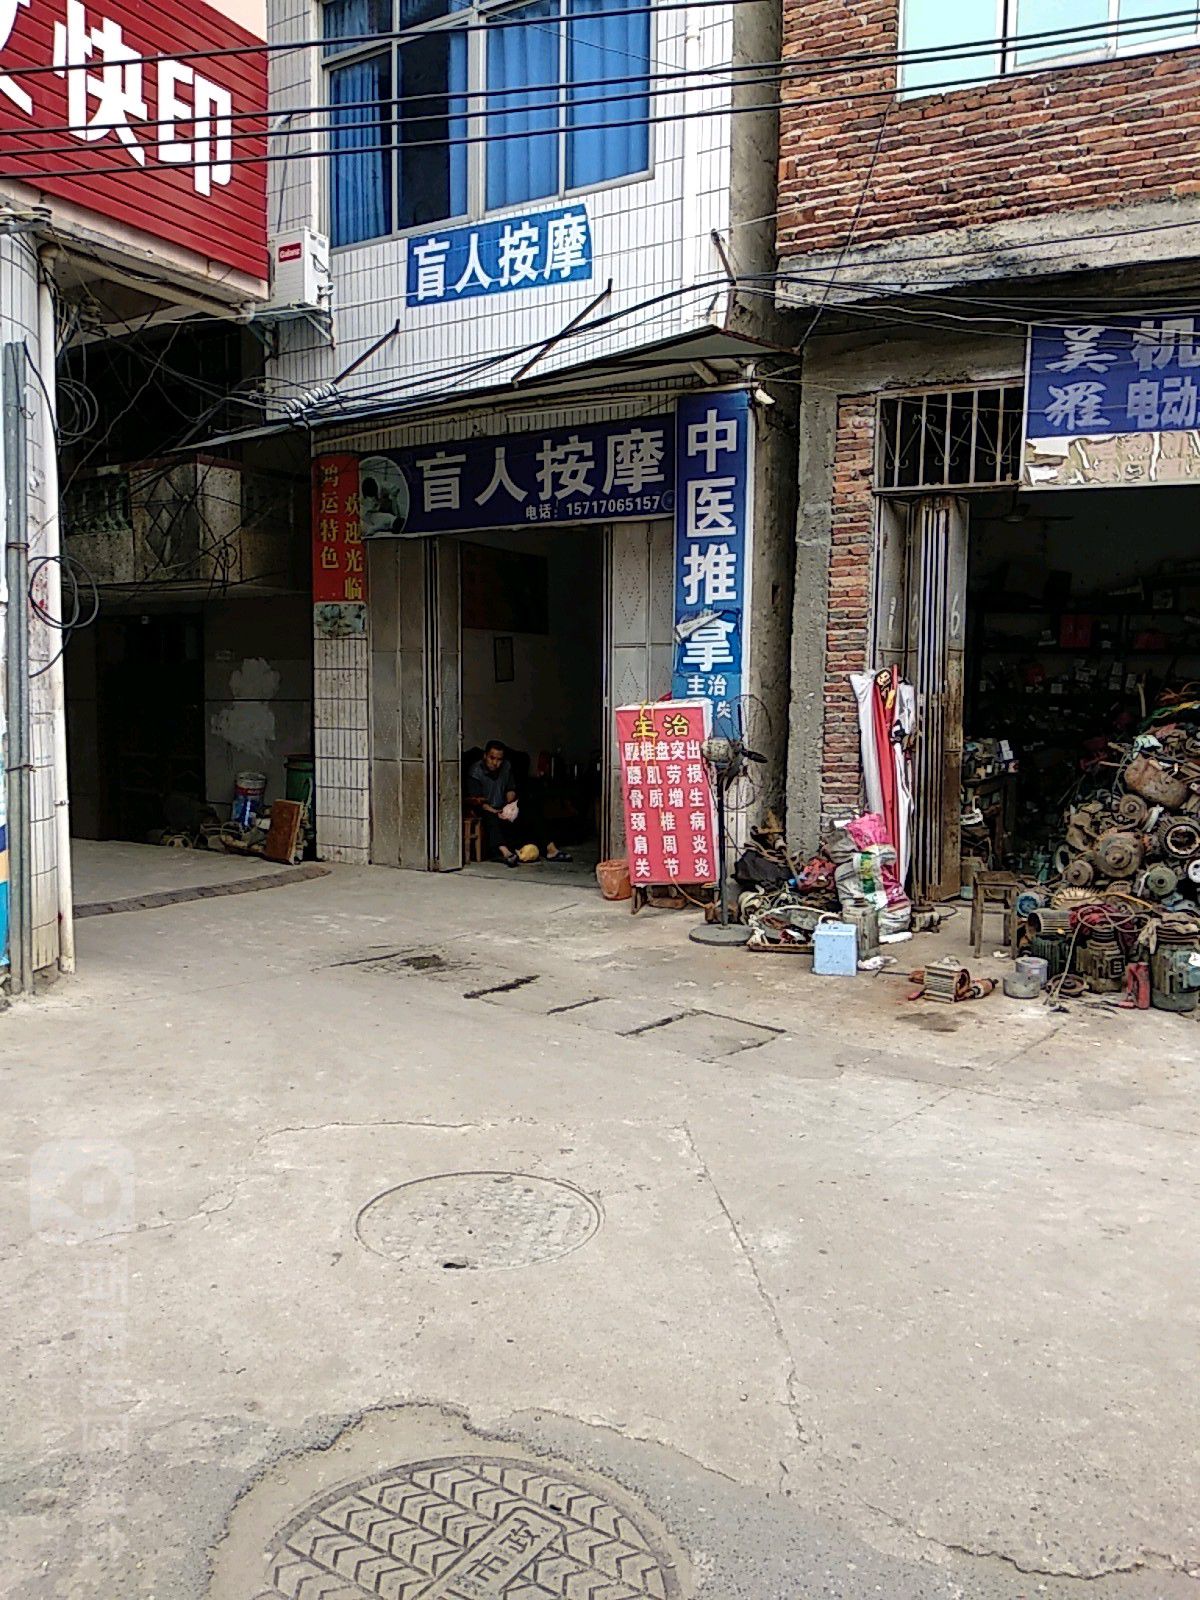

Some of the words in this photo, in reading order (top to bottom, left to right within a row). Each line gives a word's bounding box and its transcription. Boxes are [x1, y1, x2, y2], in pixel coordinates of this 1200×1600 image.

[414, 213, 587, 301] 盲人按摩
[1127, 376, 1200, 429] 电动
[415, 428, 666, 514] 盲人按摩
[343, 491, 364, 600] 欢迎光临
[682, 408, 738, 672] 中医推拿
[686, 674, 728, 697] 主治
[631, 713, 691, 738] 主治
[624, 740, 701, 762] 腰椎盘突出
[626, 763, 704, 786] 腰肌劳损
[628, 787, 706, 810] 骨质增生
[630, 811, 707, 832] 颈椎病
[632, 834, 709, 855] 肩周炎
[634, 857, 711, 878] 关节炎
